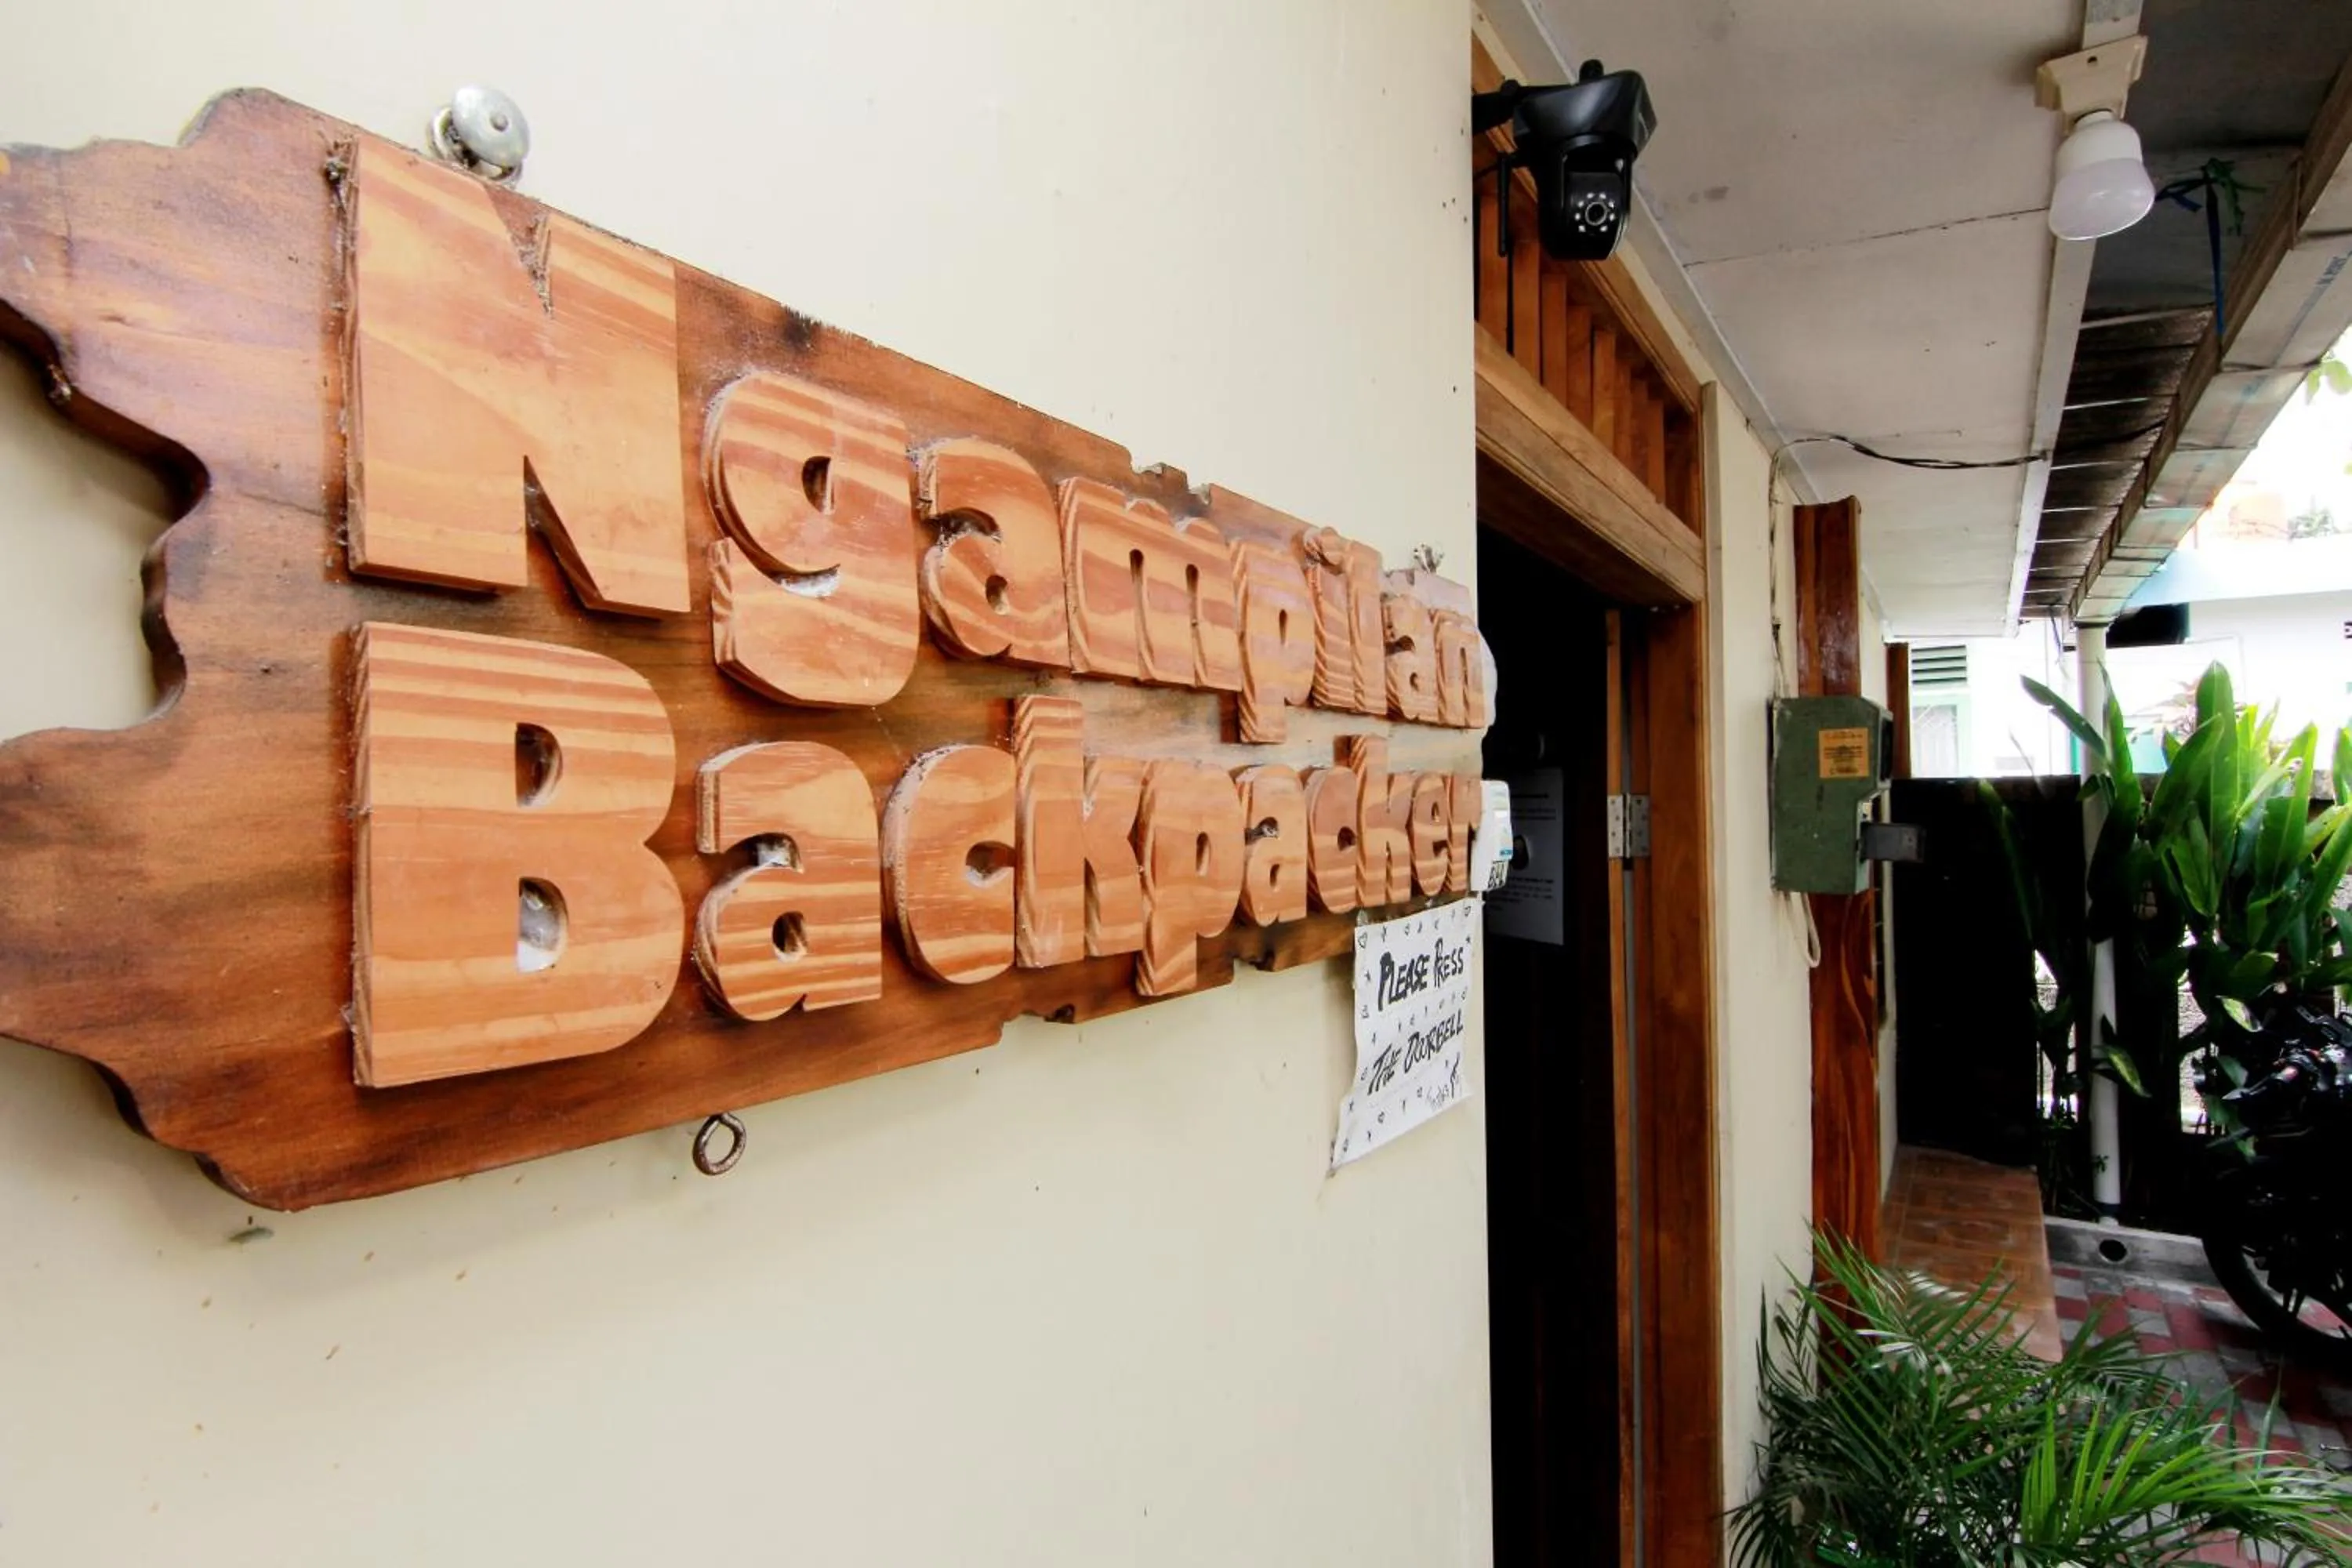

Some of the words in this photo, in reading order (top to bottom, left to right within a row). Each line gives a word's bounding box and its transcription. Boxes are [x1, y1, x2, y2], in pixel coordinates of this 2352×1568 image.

[348, 136, 1485, 745] Ngampilan
[351, 622, 1481, 1087] Backpacker
[1377, 951, 1430, 1011] PLEASE
[1434, 937, 1464, 988] PRESS
[1367, 1043, 1403, 1095] THE
